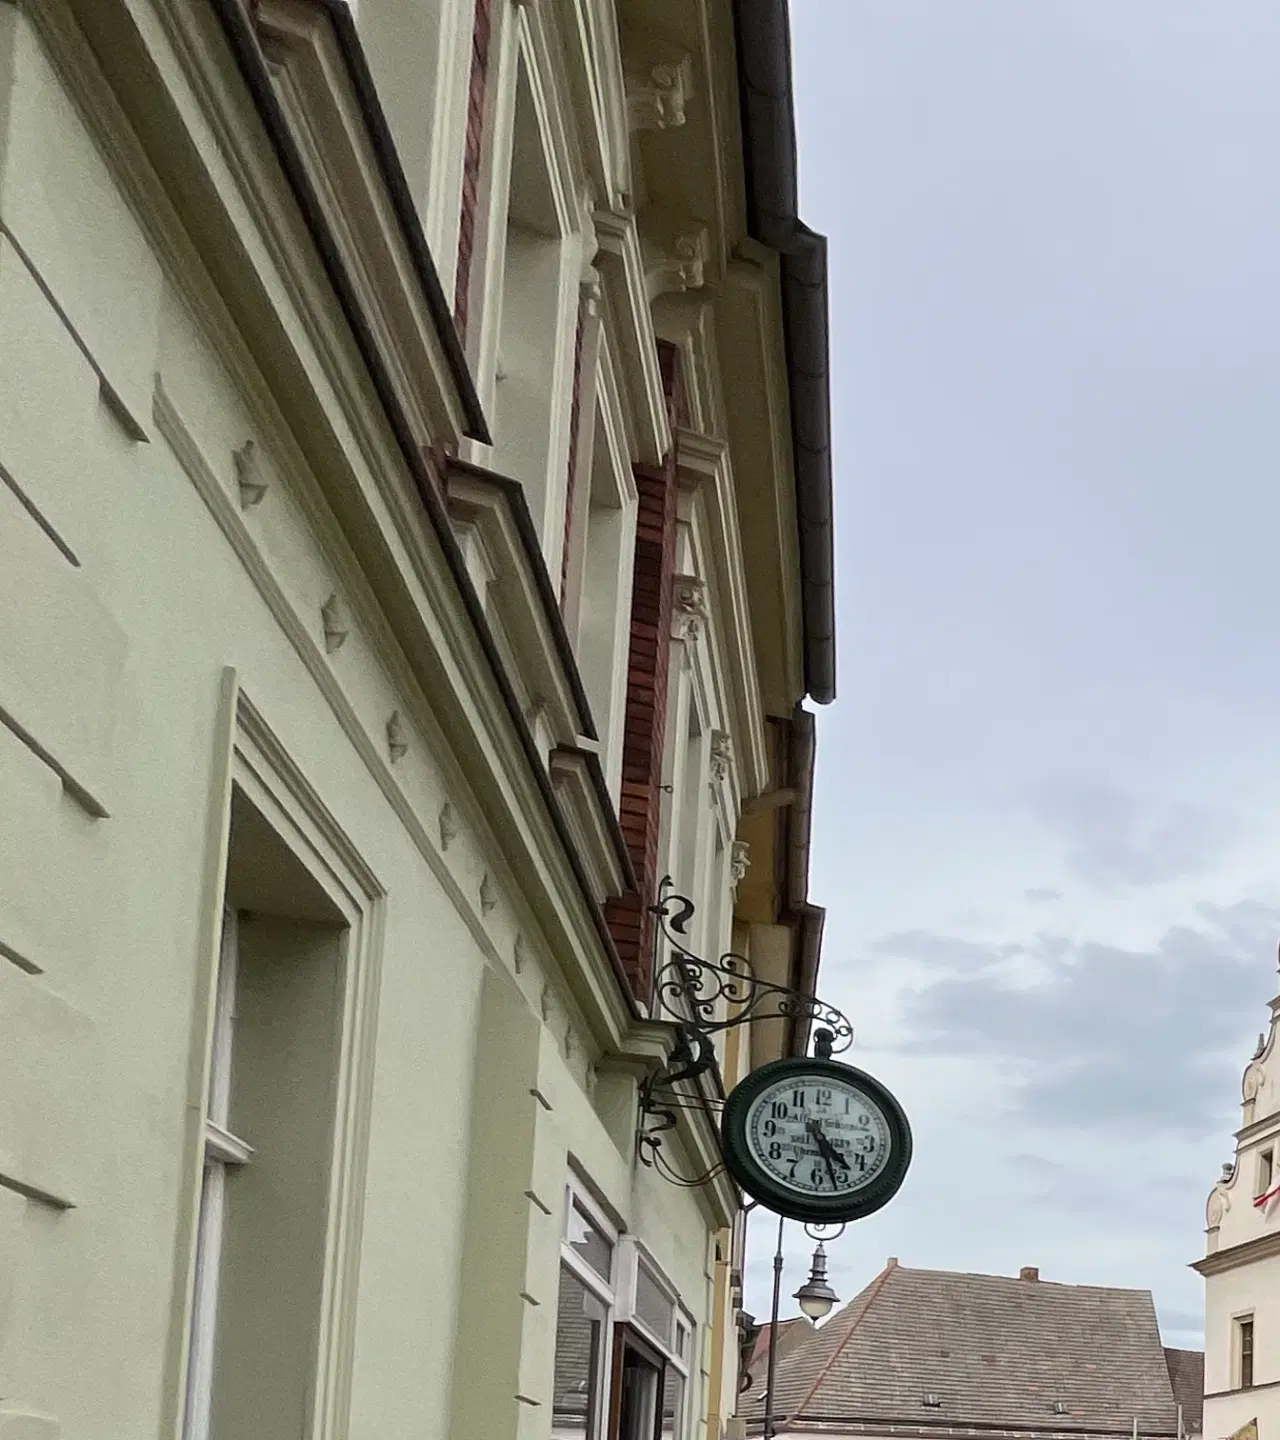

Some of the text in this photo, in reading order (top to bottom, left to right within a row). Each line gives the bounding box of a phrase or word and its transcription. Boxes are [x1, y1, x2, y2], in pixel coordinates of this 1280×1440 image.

[792, 1090, 805, 1108] 11
[815, 1089, 832, 1106] 12
[844, 1097, 850, 1115] 1
[771, 1101, 788, 1120] 10
[763, 1120, 777, 1138] 9
[768, 1141, 782, 1160] 8
[863, 1135, 875, 1153] 3
[785, 1158, 799, 1178] 7
[854, 1153, 868, 1172] 4
[810, 1168, 823, 1186] 6
